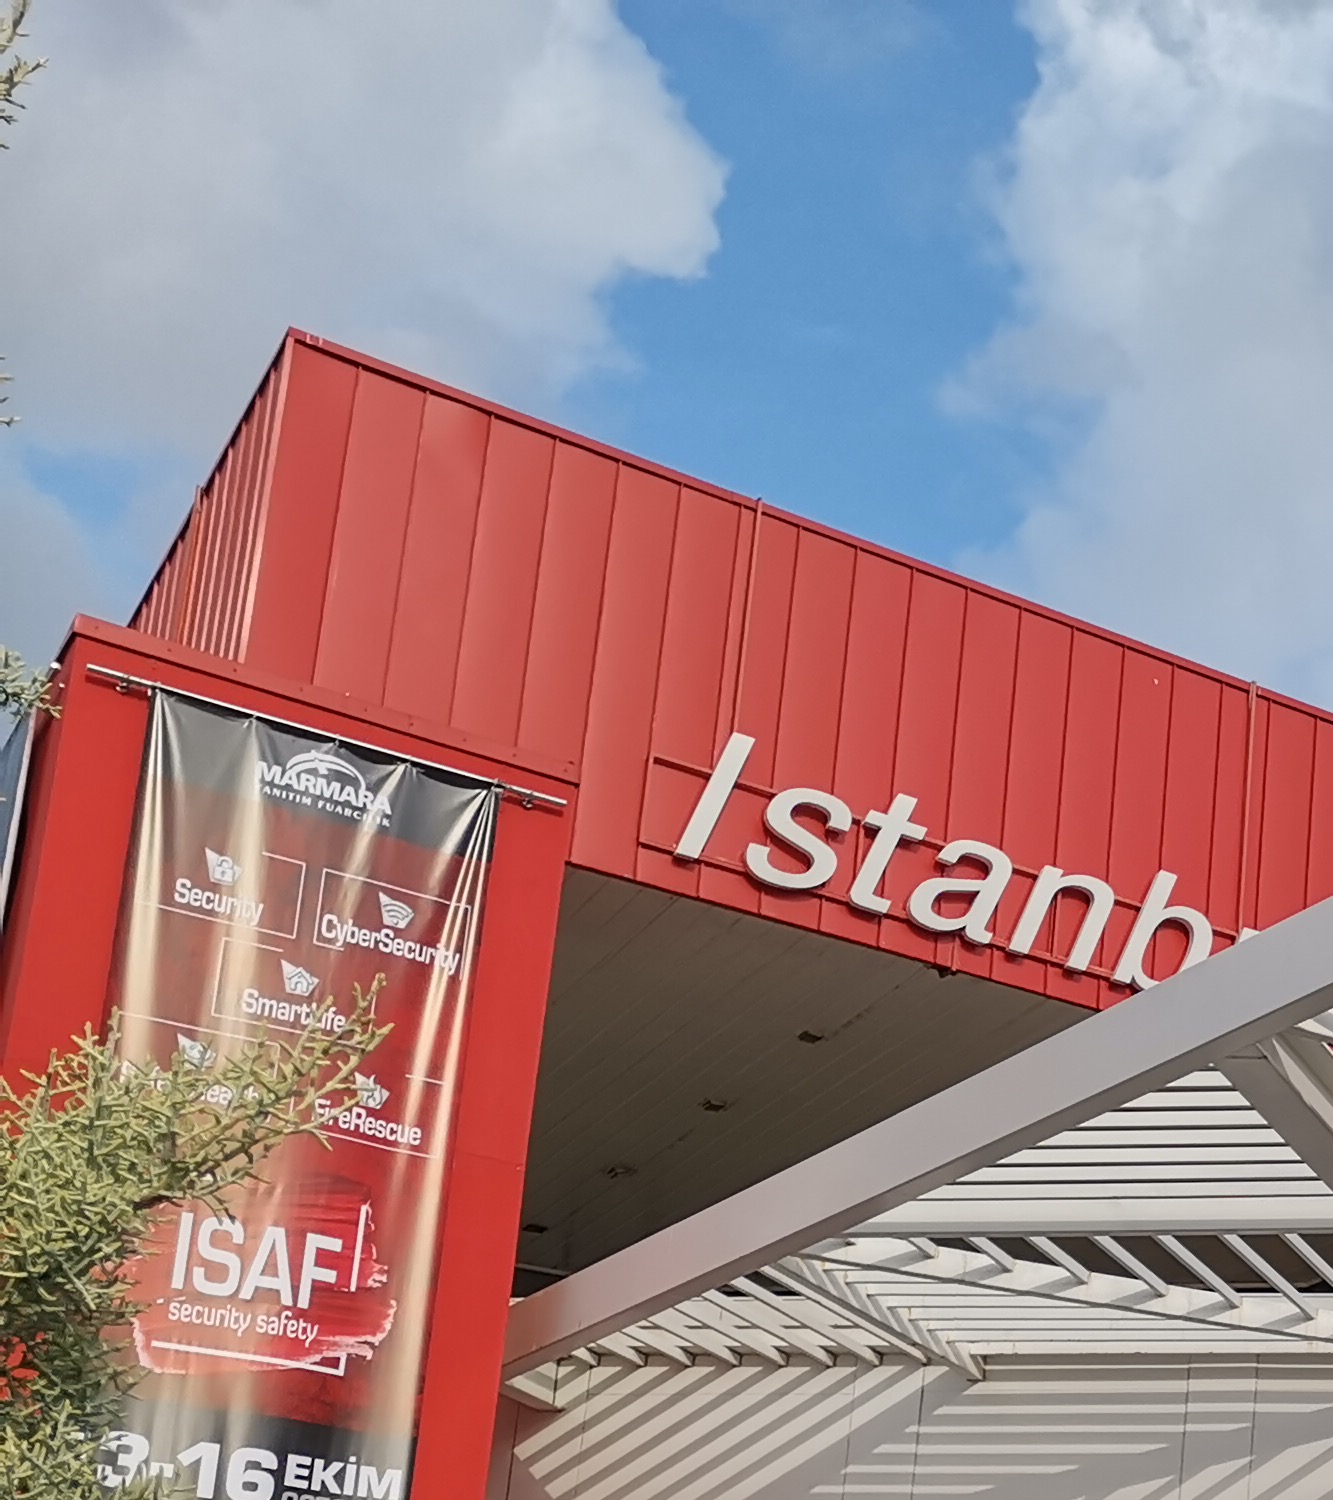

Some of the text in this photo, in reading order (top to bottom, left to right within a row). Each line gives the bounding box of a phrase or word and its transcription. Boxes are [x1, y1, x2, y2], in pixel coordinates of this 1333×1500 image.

[258, 761, 392, 815] MARMARA
[318, 800, 391, 827] FUARCIIK
[673, 731, 1262, 992] Istanb
[174, 878, 264, 926] Security
[321, 914, 460, 976] CyberSecurity
[170, 1212, 343, 1309] ISAF
[168, 1301, 319, 1347] security safety
[284, 1456, 402, 1500] EKİM
